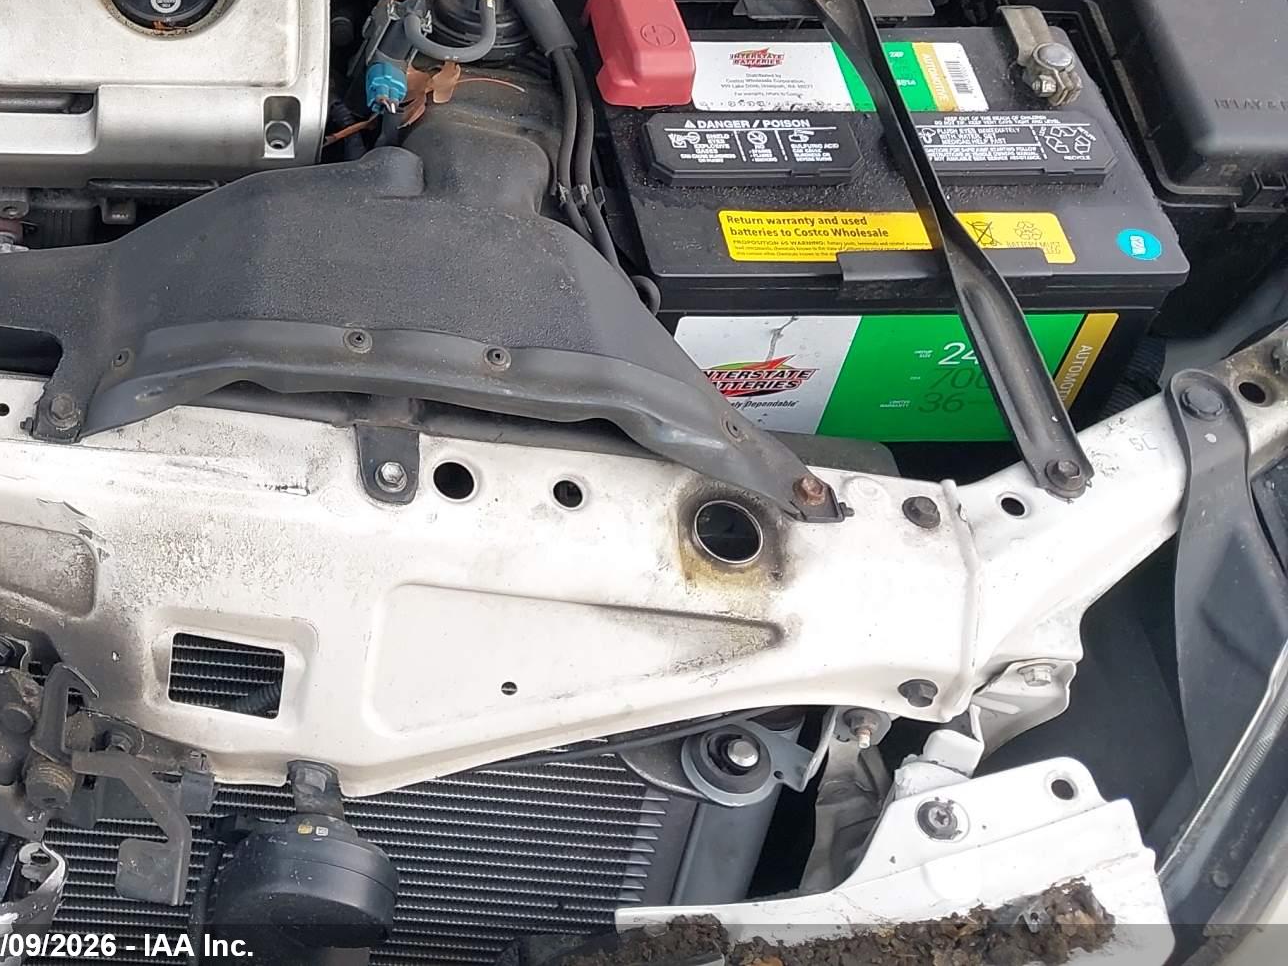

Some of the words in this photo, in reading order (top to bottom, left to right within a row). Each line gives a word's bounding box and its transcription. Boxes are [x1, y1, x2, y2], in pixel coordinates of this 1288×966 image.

[696, 120, 750, 129] DANGER
[762, 119, 810, 128] POISON
[726, 215, 763, 225] Return
[766, 217, 815, 227] warranty
[818, 216, 838, 226] and
[841, 216, 868, 226] used
[730, 227, 778, 237] batteries
[780, 228, 792, 237] to
[794, 228, 830, 237] Costco
[831, 228, 889, 238] Wholesale
[703, 370, 811, 380] NTERSTATE
[744, 400, 796, 409] Dependable
